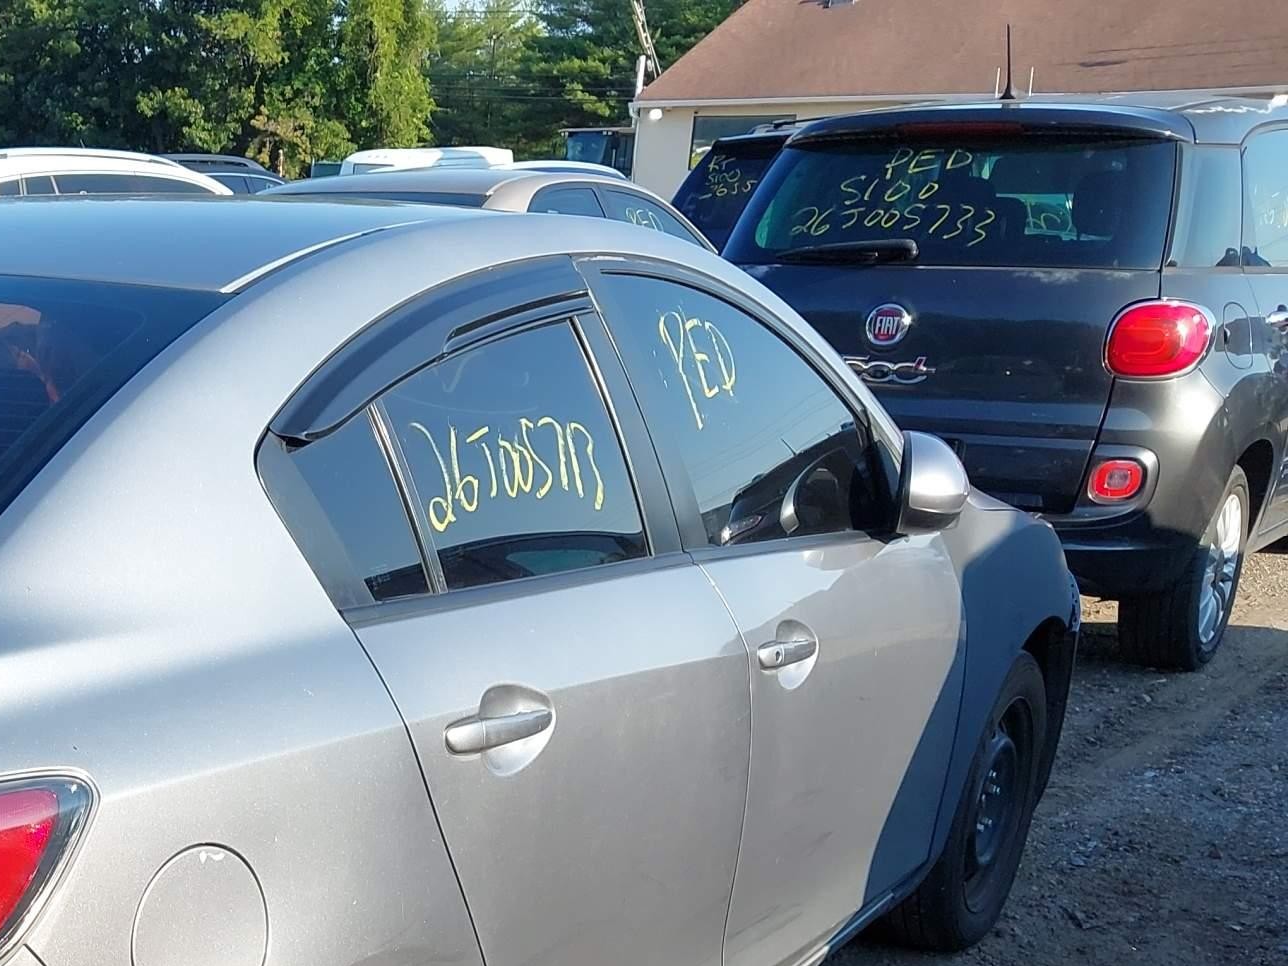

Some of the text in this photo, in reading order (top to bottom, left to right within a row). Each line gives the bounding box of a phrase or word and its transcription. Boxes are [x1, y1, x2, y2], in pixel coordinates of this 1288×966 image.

[885, 149, 973, 180] PED
[840, 175, 939, 205] S100
[875, 316, 901, 335] FIAT
[659, 305, 736, 430] PED
